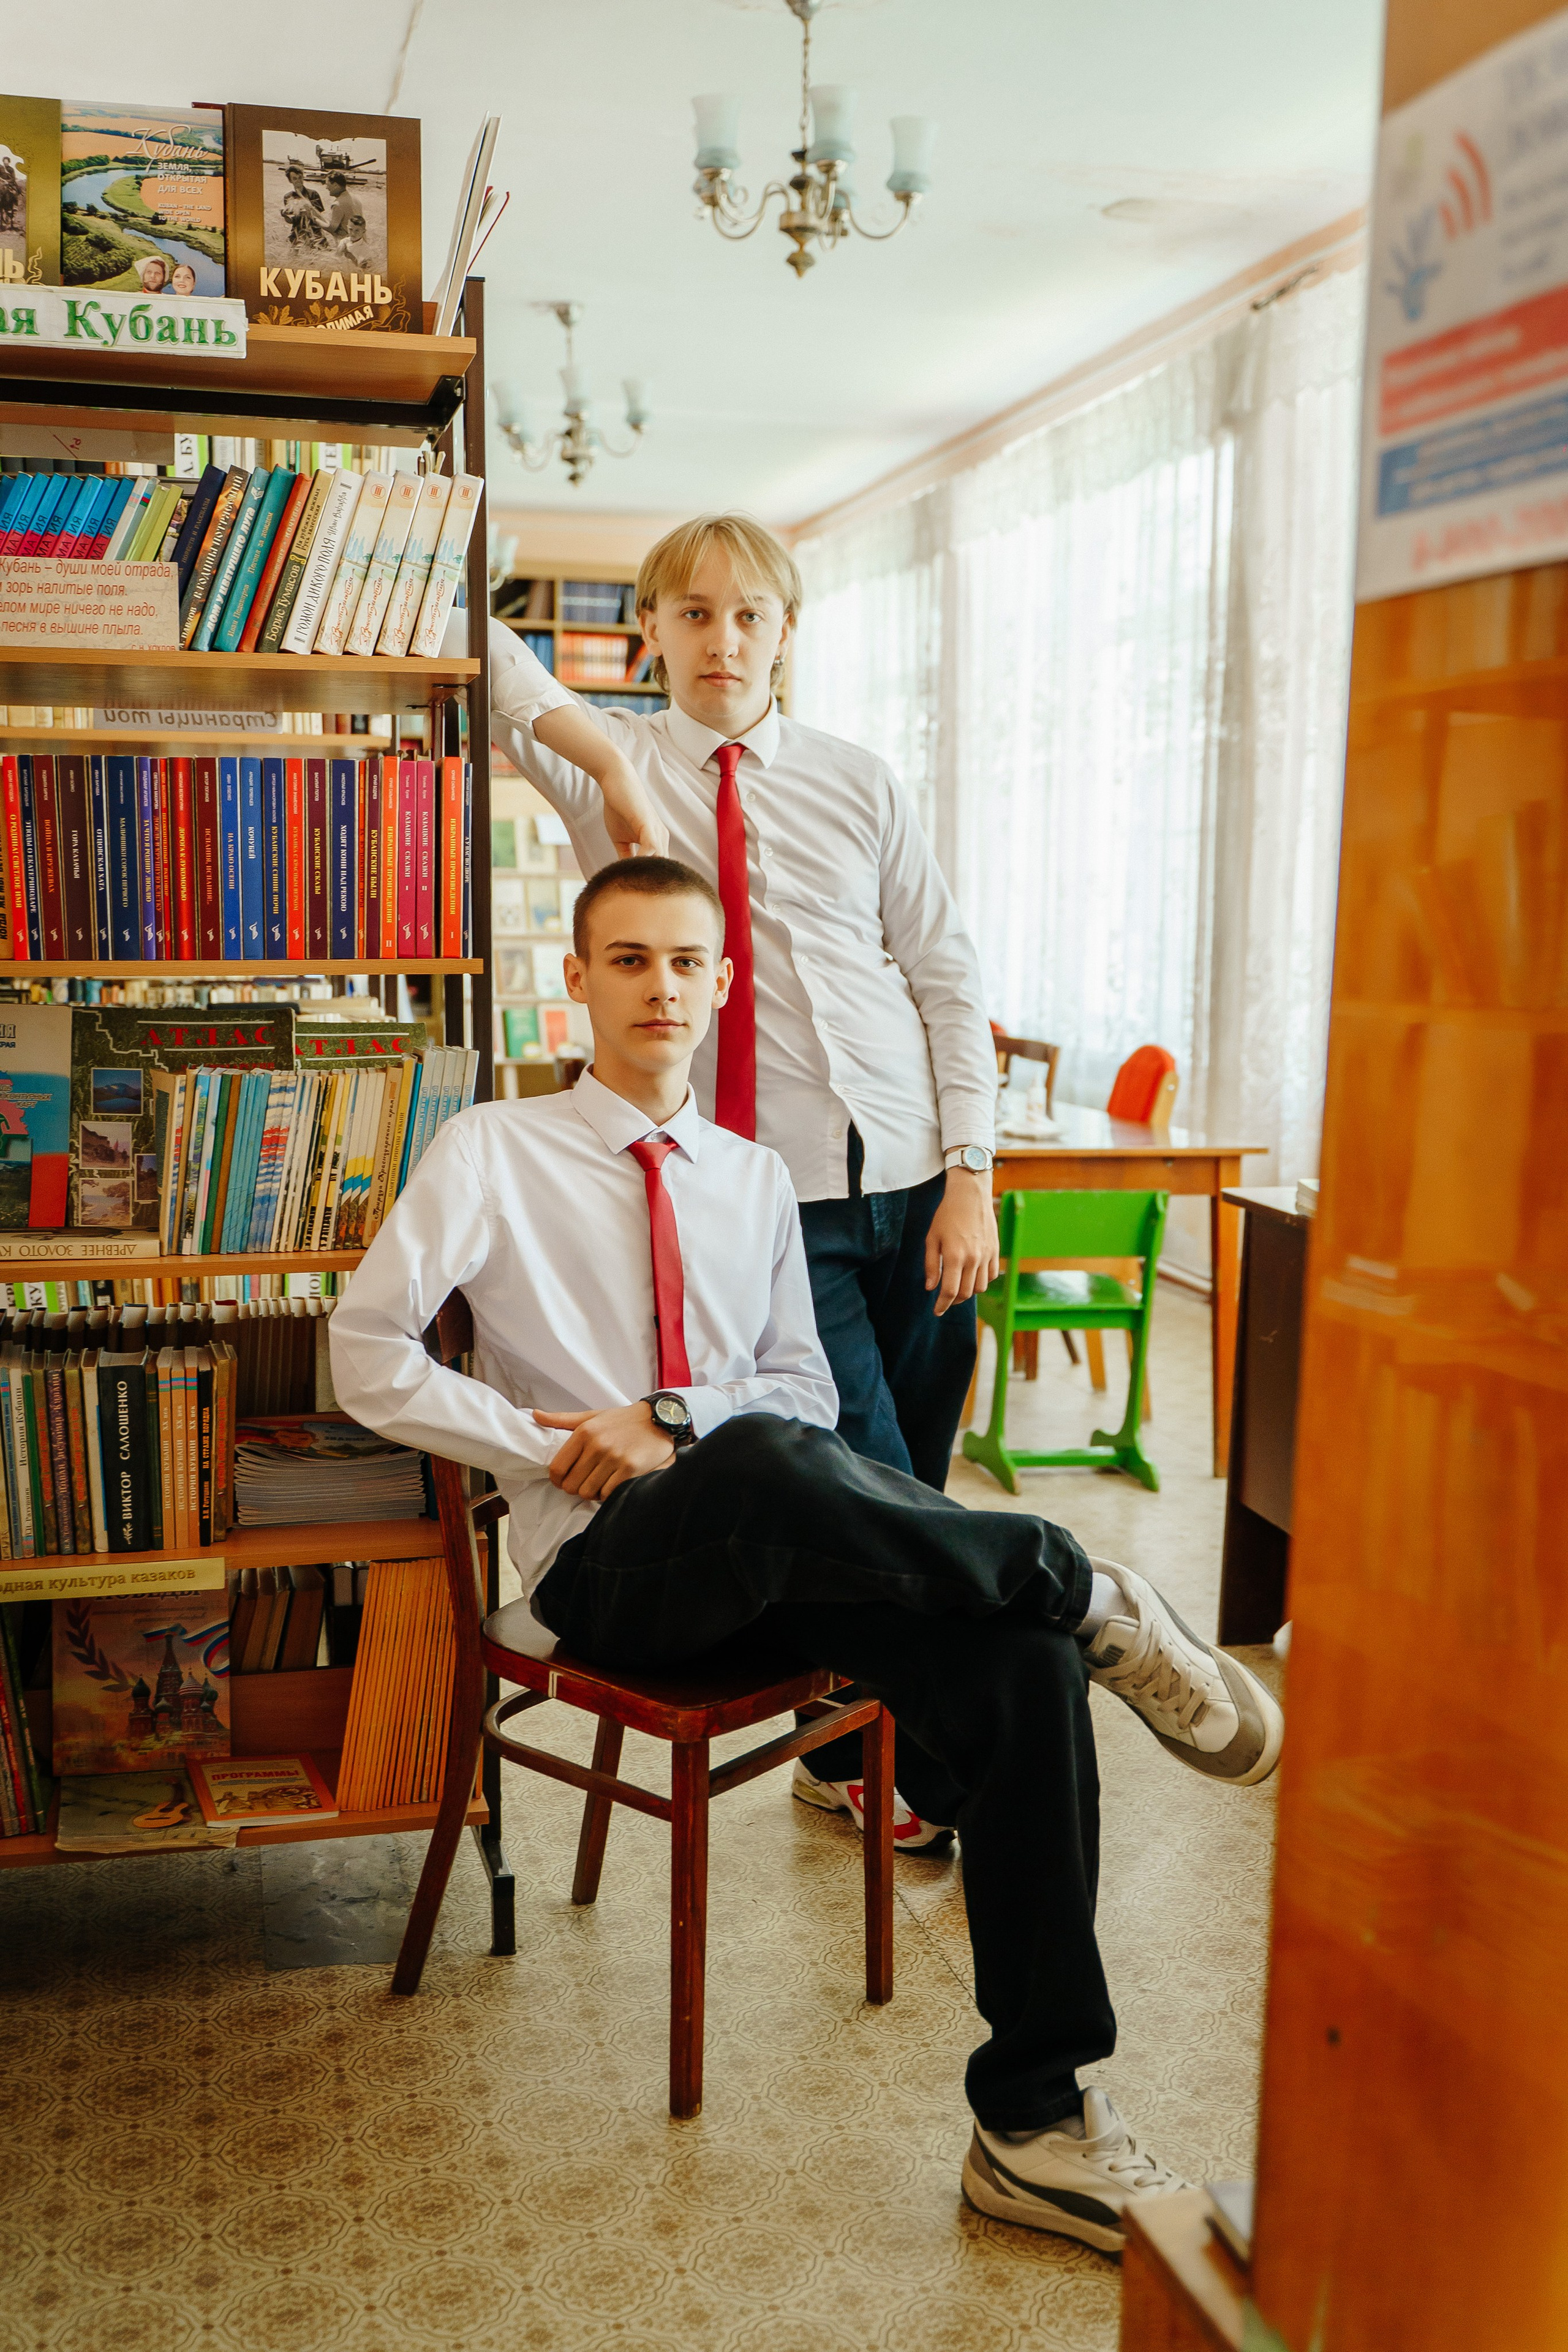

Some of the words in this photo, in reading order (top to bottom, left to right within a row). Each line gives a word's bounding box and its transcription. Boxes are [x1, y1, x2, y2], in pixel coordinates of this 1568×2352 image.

[126, 124, 208, 173] Кубань
[158, 162, 192, 172] ЗЕМЛЯ,
[158, 174, 207, 183] ОТКРЫТАЯ
[260, 266, 393, 304] КУБАНЬ
[62, 299, 239, 347] Кубань
[318, 537, 336, 564] ПОЛЯ
[0, 559, 41, 576] Кубань
[56, 559, 87, 578] души
[91, 562, 120, 576] моей
[124, 564, 173, 579] отрада,
[197, 547, 219, 590] ГОДИНЫ
[208, 605, 222, 631] ДОМ
[215, 593, 225, 603] У
[220, 535, 247, 594] ЦВЕТУЩЕГО
[306, 564, 330, 603] ДИКОГО
[6, 582, 32, 596] зорь
[37, 582, 92, 595] налитые
[97, 585, 127, 596] поля.
[227, 620, 238, 637] Иван
[249, 549, 262, 573] Погоня
[265, 606, 286, 641] Борис
[277, 564, 301, 610] Тумасов
[31, 603, 59, 617] мире
[65, 605, 104, 615] ничего
[109, 606, 123, 615] не
[127, 603, 157, 618] надо,
[296, 602, 317, 635] ГОМОН
[1, 622, 36, 633] песня
[40, 622, 45, 633] в
[51, 623, 98, 633] вышине
[102, 624, 143, 635] плыла.
[10, 822, 18, 854] РОДИНА!
[228, 833, 234, 842] НА
[12, 856, 21, 889] СВЕТЛОЕ
[27, 855, 36, 913] ЕКАТЕРИНОДАРЕ
[141, 1026, 275, 1045] АТЛАС
[388, 1164, 397, 1197] ПАМЯТНИКИ
[20, 1245, 73, 1256] ЗОЛОТО
[81, 1245, 137, 1256] ДРЕВНЕЕ
[14, 1387, 24, 1423] Кубани
[117, 1381, 130, 1460] САЛОШЕНКО
[17, 1426, 28, 1466] История
[121, 1471, 132, 1519] ВИКТОР
[49, 1576, 126, 1591] культура
[131, 1569, 195, 1583] казаков
[212, 1770, 299, 1781] ПРОГРАММЫ
